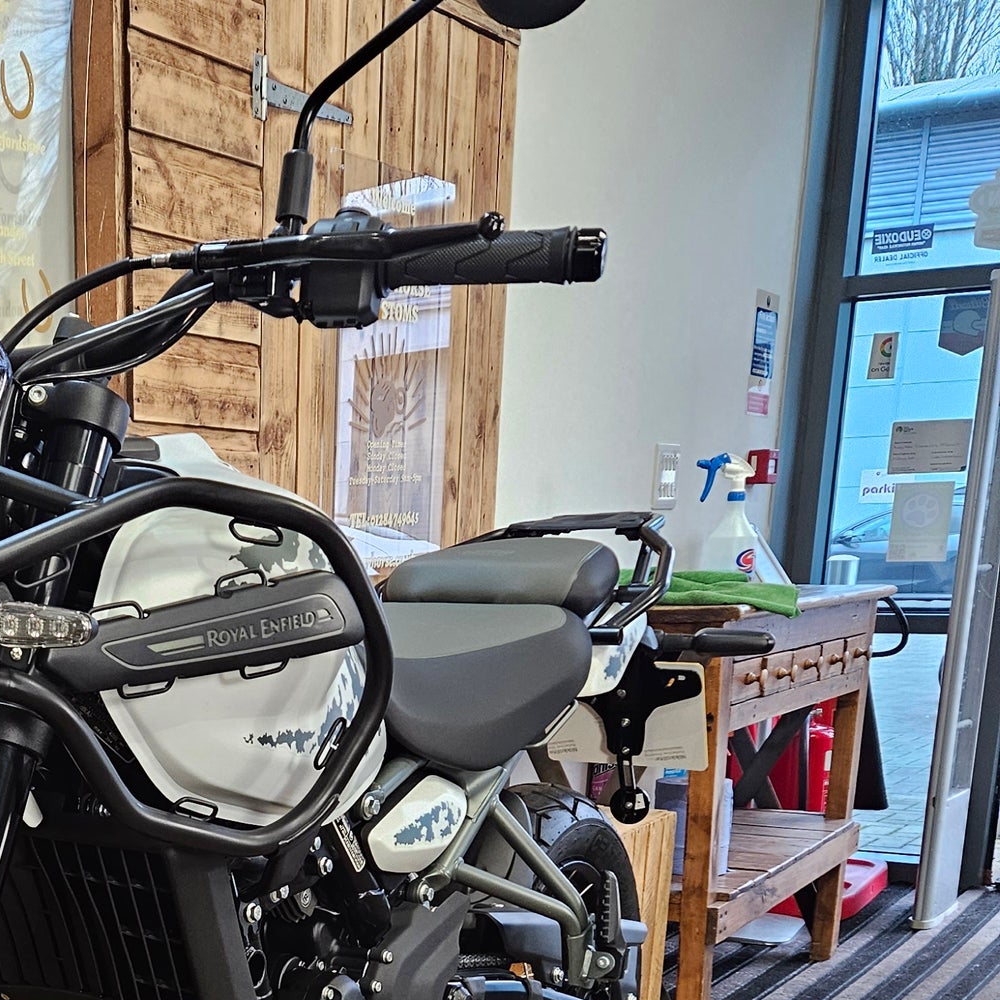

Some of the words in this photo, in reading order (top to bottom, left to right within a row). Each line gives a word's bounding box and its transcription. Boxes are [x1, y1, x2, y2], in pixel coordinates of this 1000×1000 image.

[381, 300, 419, 323] STOMS
[862, 483, 895, 496] parki
[206, 624, 259, 648] ROYAL
[260, 611, 317, 640] ENFIELD
